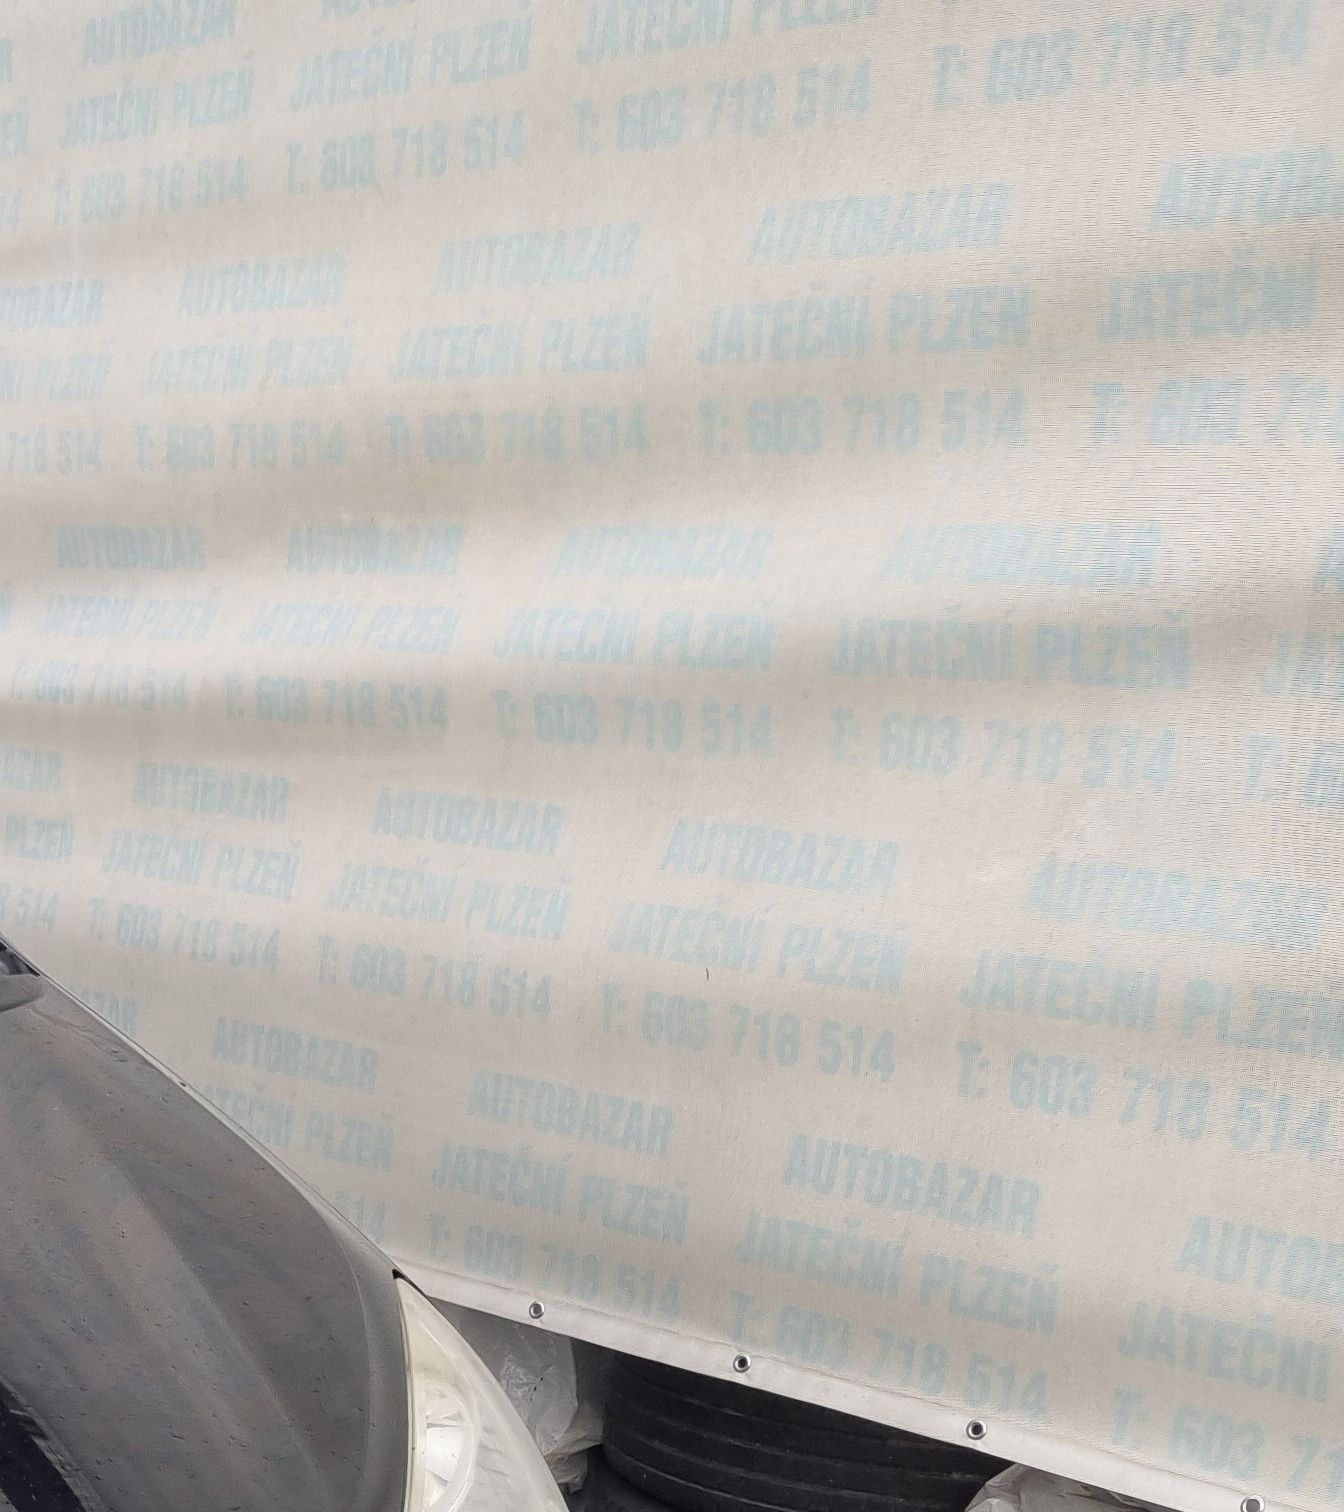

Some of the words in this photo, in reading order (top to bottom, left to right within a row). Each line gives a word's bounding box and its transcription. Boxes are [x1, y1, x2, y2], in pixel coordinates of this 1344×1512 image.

[371, 785, 565, 854] AUTOBAZAR
[661, 819, 898, 895] AUTOBAZAR
[643, 989, 708, 1049] 603
[731, 1004, 800, 1069] 718
[817, 1019, 894, 1083] 514
[468, 1071, 673, 1156] AUTOBAZAR
[783, 1134, 1041, 1236] AUTOBAZAR
[1171, 1408, 1263, 1478] 603
